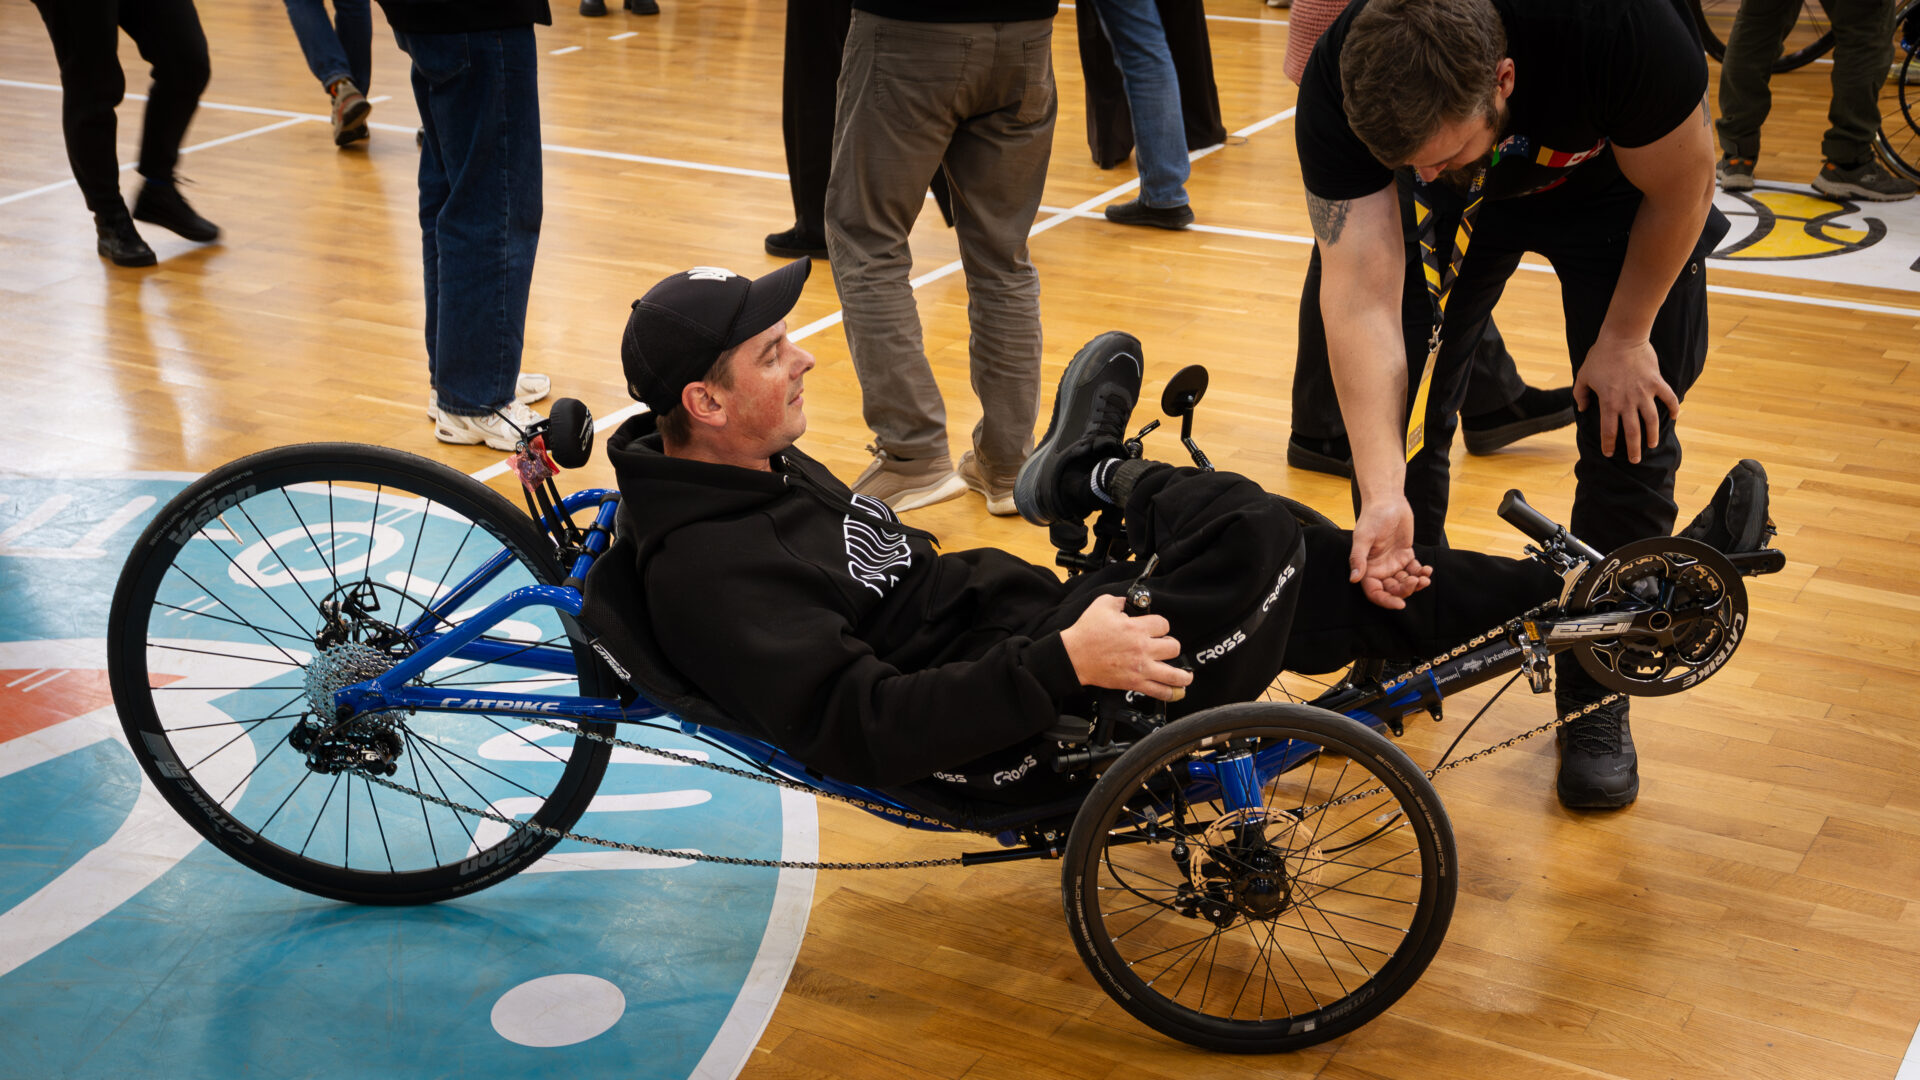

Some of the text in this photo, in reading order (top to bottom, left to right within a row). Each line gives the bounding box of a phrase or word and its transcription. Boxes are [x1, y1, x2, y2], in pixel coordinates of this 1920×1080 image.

[168, 484, 257, 546] Vision
[1262, 564, 1296, 612] CROSS
[1196, 630, 1247, 664] CROSS
[1682, 612, 1744, 688] CATRIKE
[440, 697, 561, 713] CATRIKE
[993, 755, 1037, 785] CROSS
[178, 778, 255, 845] CATRIKE
